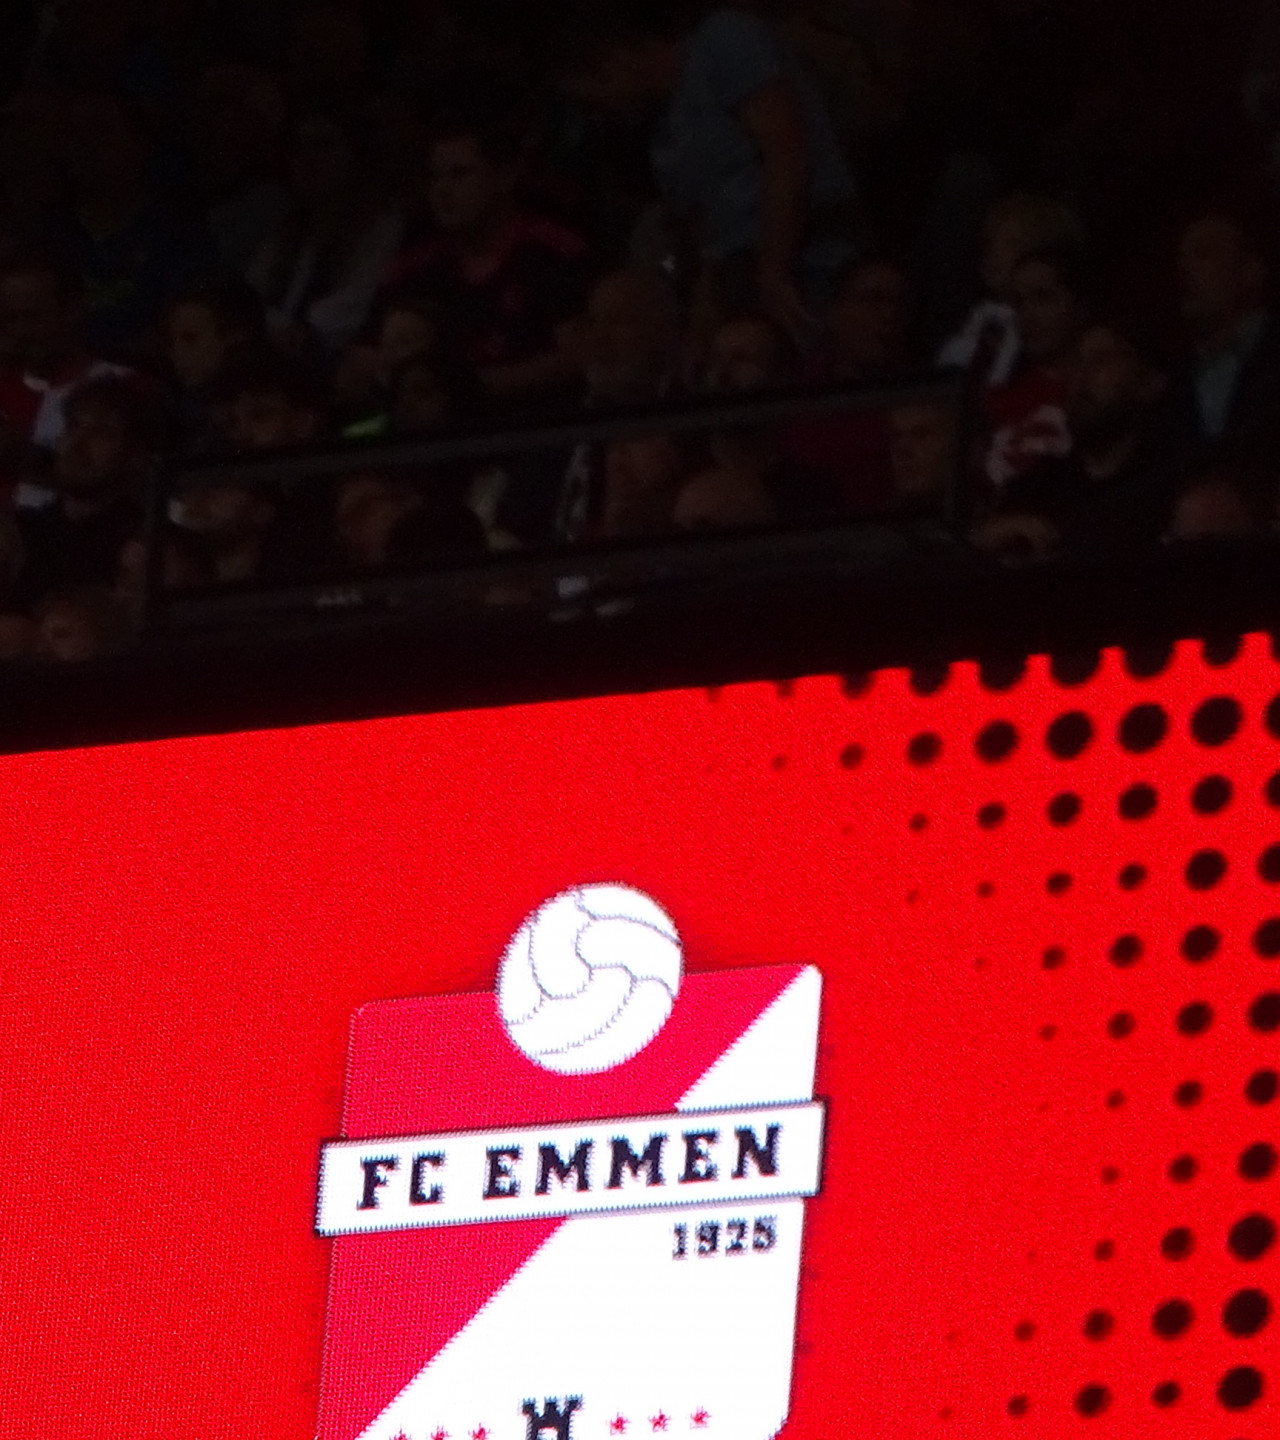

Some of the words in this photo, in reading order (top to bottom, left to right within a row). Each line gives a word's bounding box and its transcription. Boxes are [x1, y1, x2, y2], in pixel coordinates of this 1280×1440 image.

[359, 1155, 444, 1210] FC
[484, 1125, 783, 1199] EMMEN
[671, 1217, 777, 1261] 1925
